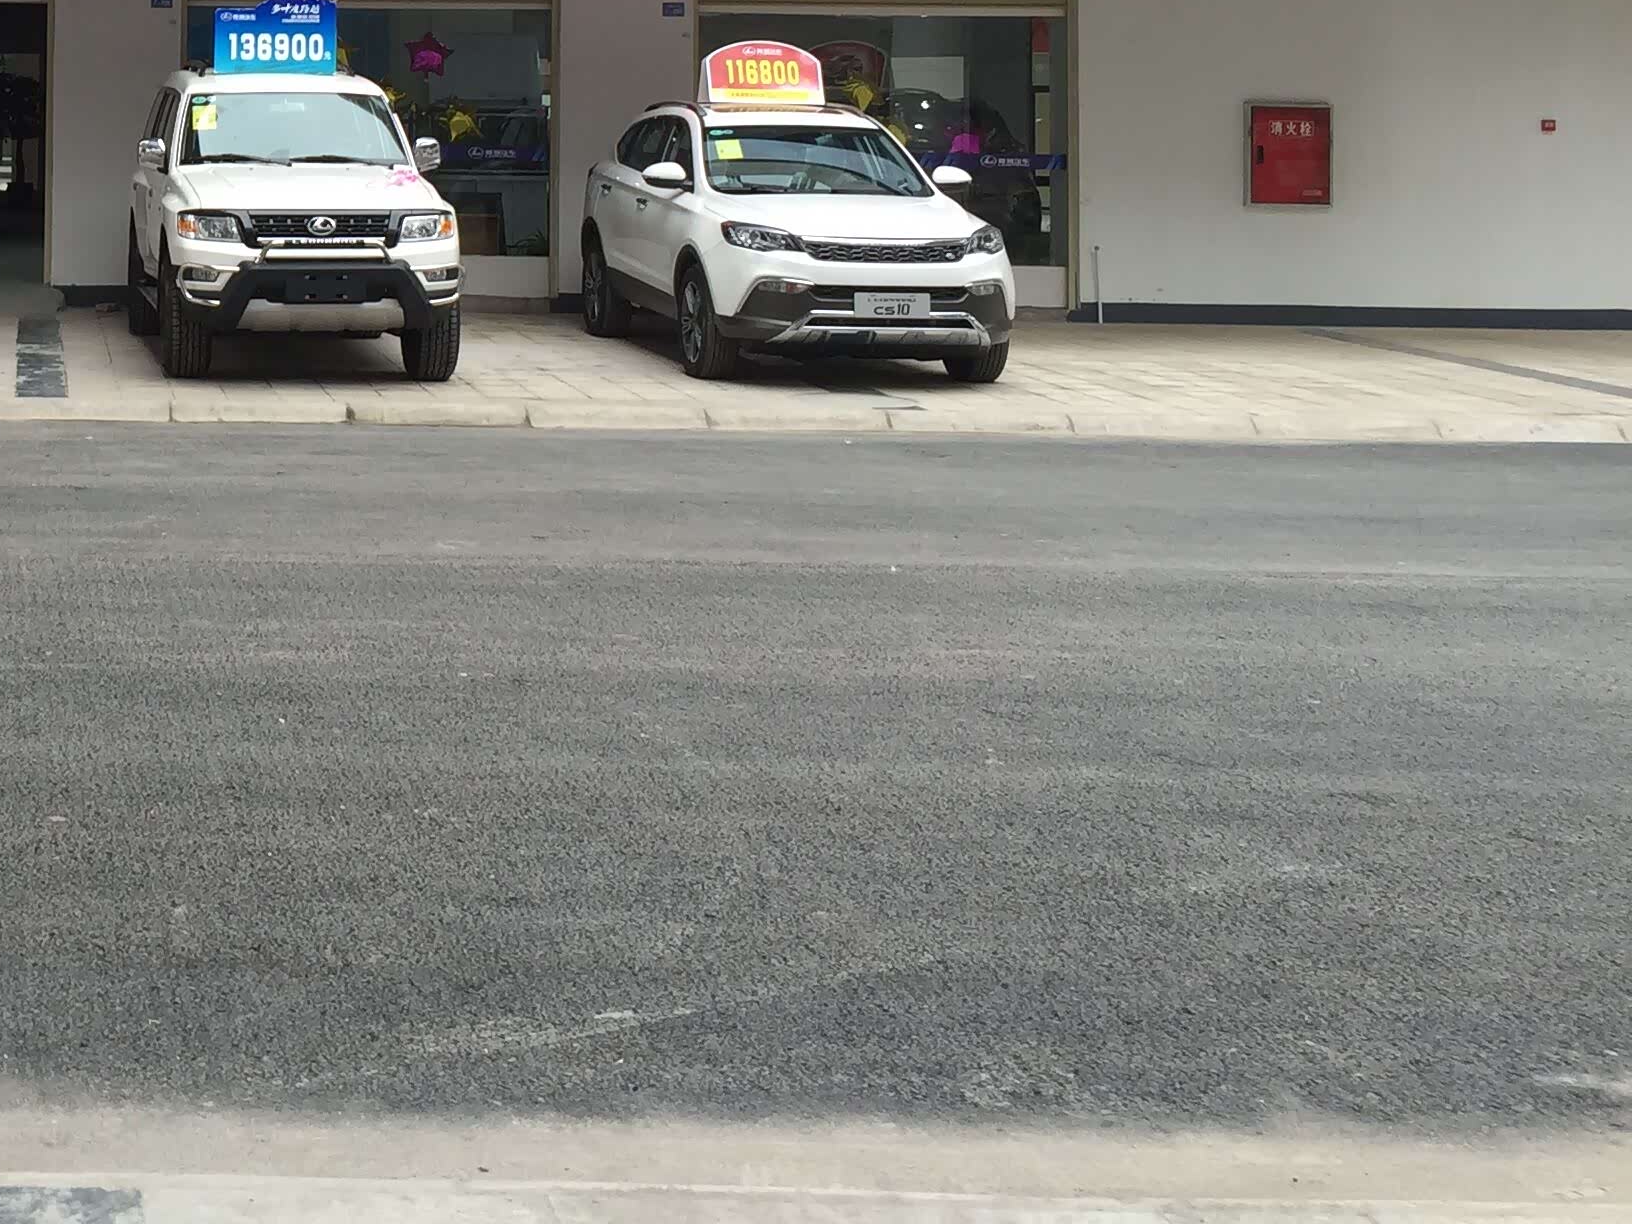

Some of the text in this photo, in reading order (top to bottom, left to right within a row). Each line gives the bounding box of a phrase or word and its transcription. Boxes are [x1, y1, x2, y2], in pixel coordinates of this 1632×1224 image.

[725, 59, 800, 86] 116800
[1270, 121, 1313, 137] 消火栓
